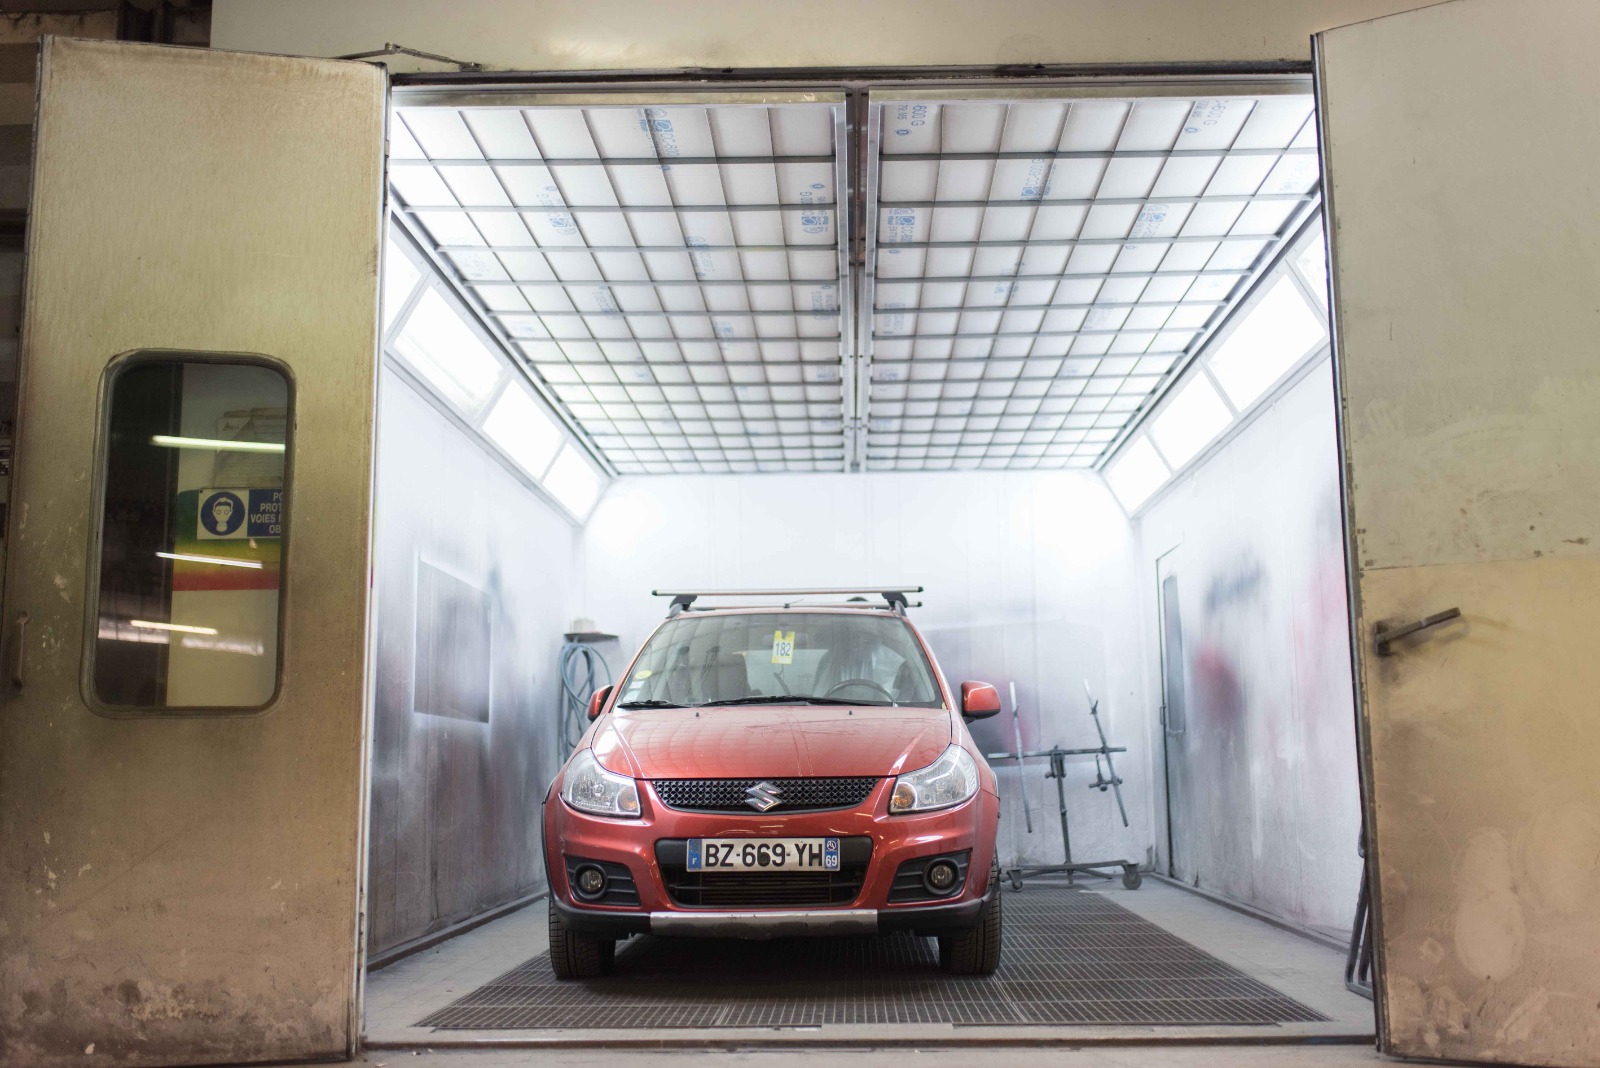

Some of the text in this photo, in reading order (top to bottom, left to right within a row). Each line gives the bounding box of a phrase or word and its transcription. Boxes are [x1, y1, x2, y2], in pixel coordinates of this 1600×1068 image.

[250, 513, 276, 523] VOIES
[776, 641, 791, 657] 182
[691, 857, 697, 865] F
[705, 843, 822, 867] BZ-669-YH
[825, 855, 838, 867] 69
